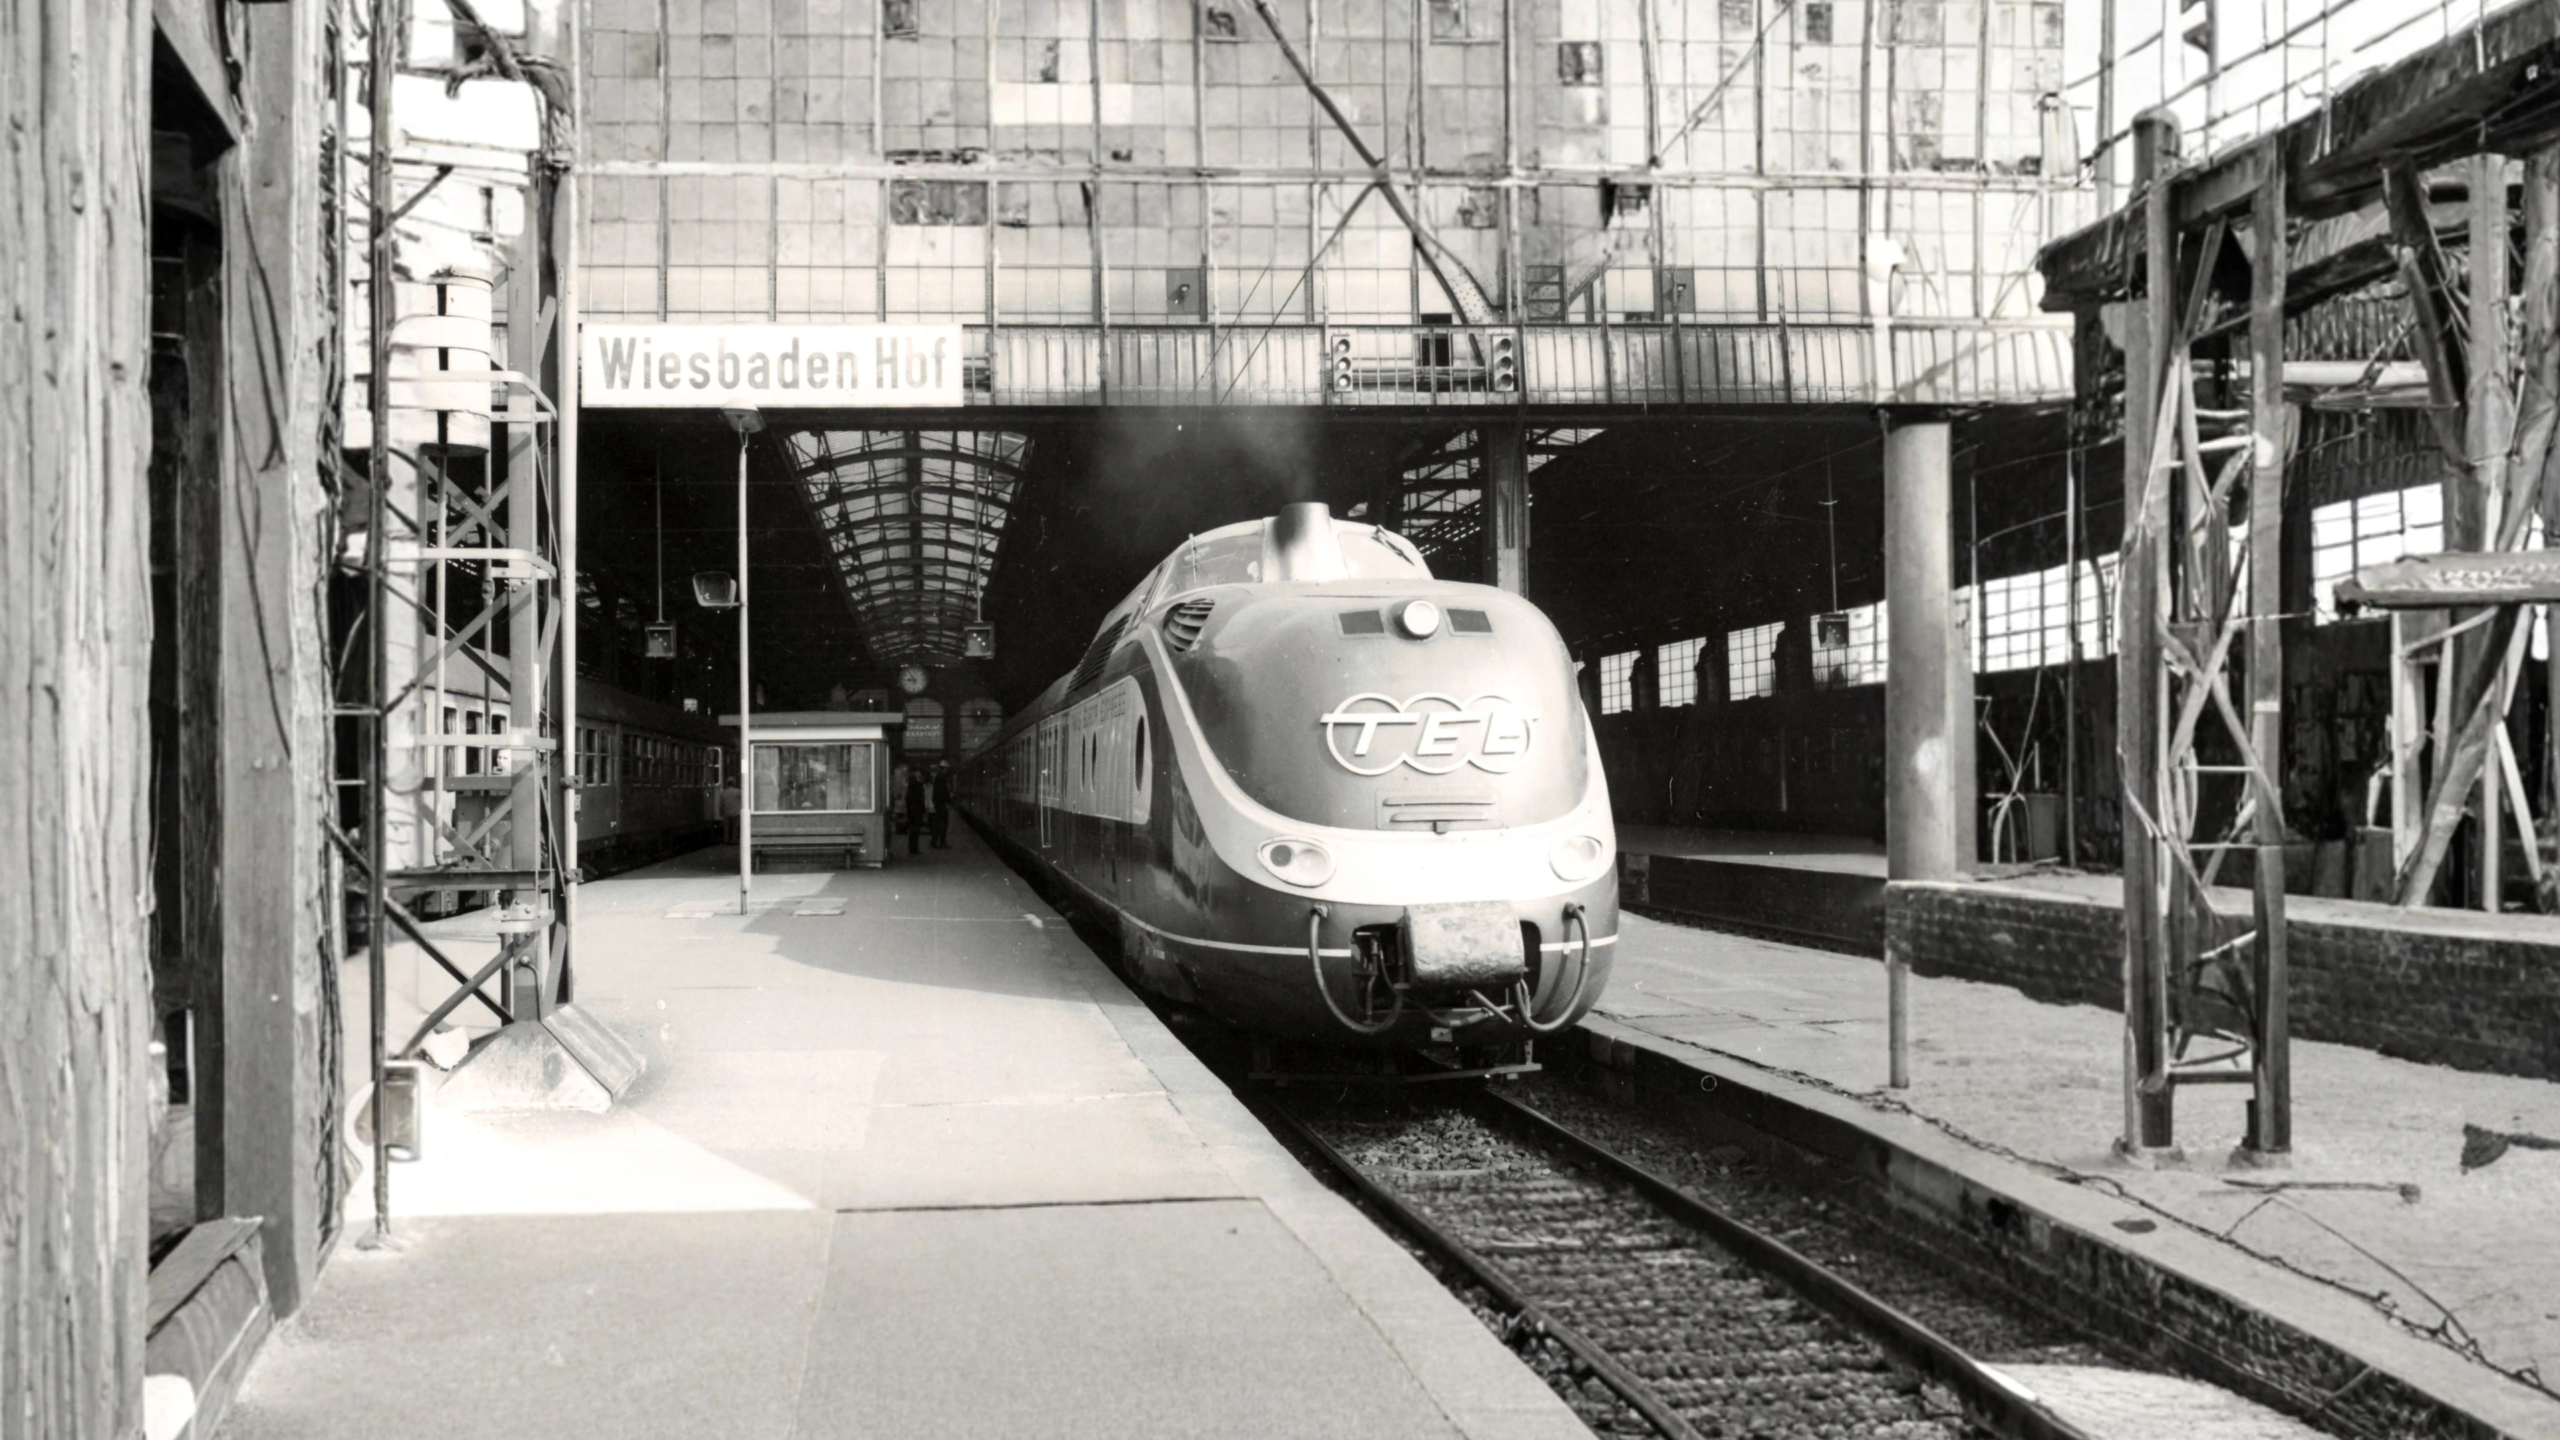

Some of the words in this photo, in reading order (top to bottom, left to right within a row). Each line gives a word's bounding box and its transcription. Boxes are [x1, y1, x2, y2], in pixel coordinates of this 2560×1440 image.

[598, 336, 859, 390] Wiesbaden
[875, 336, 948, 390] Hbf
[1319, 711, 1542, 757] TEE
